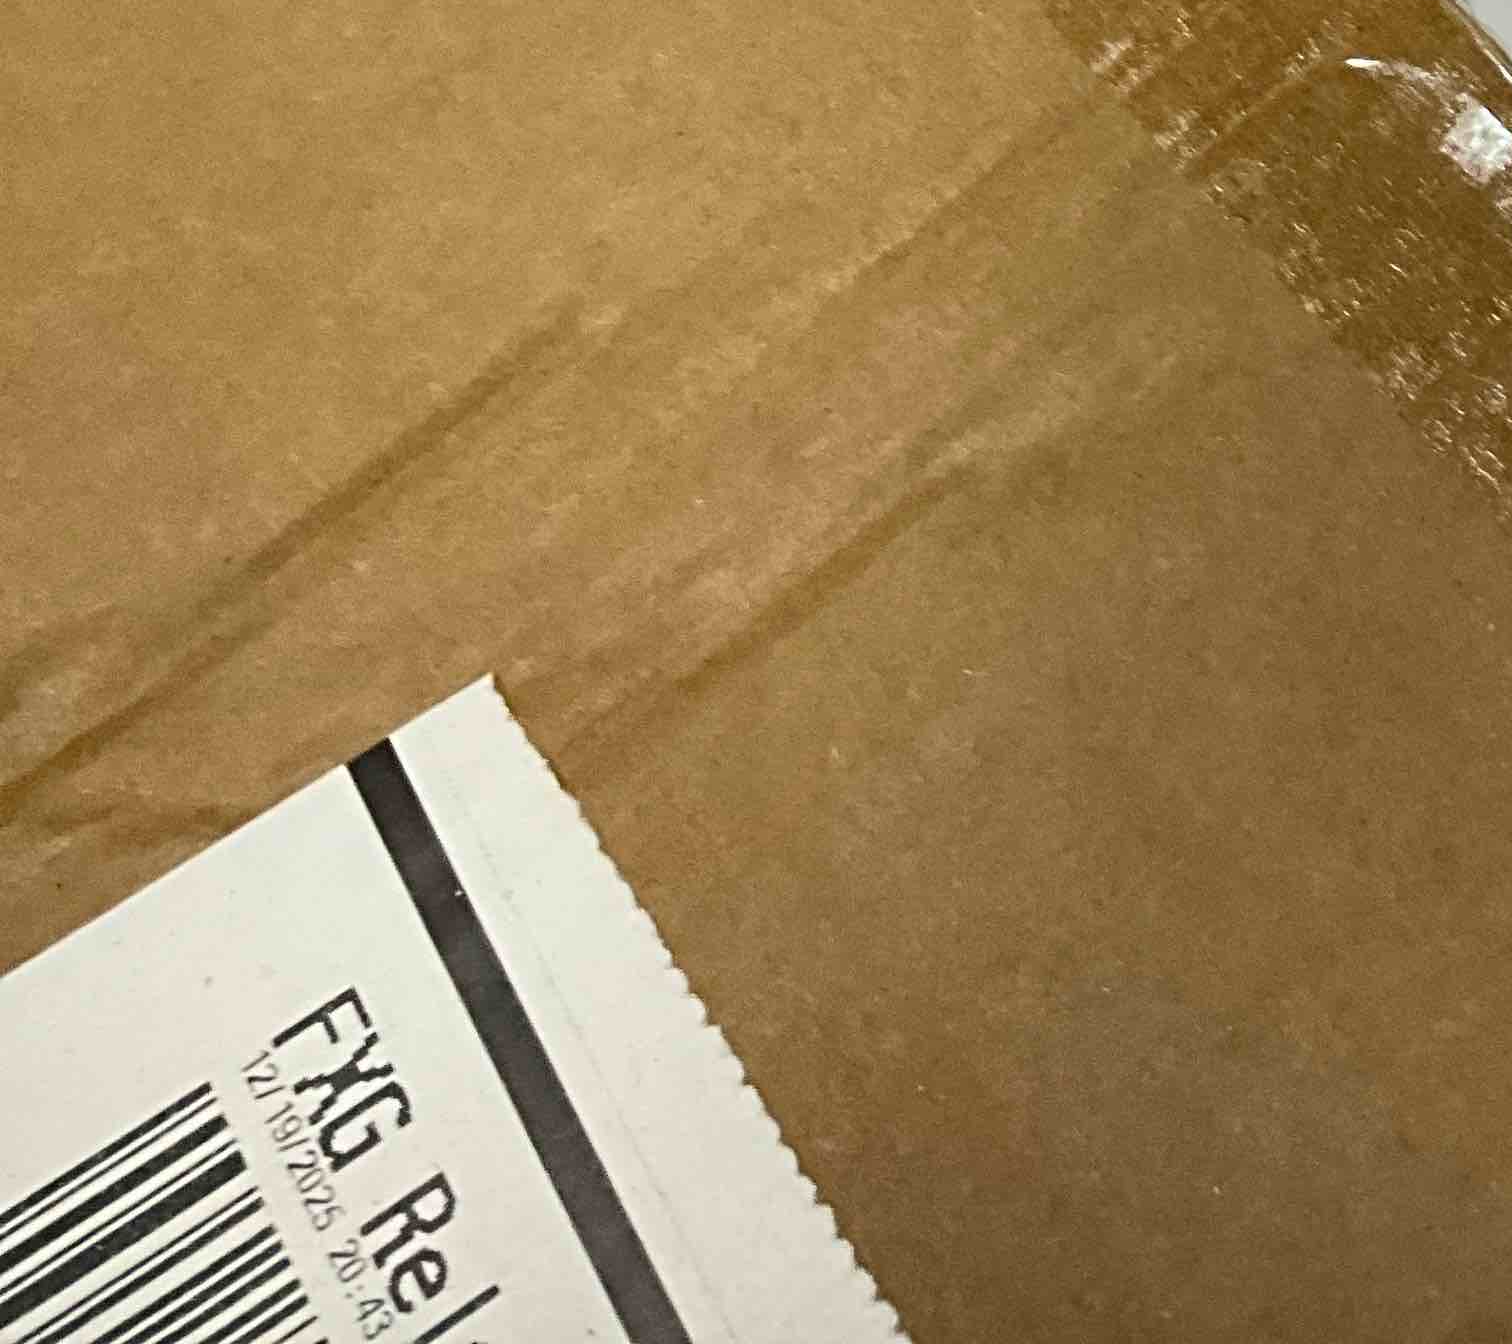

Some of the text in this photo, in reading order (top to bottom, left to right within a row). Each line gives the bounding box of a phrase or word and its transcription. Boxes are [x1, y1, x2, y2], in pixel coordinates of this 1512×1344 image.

[241, 1049, 395, 1341] 12/19/2025 20:43
[272, 986, 500, 1344] FXG Rel
